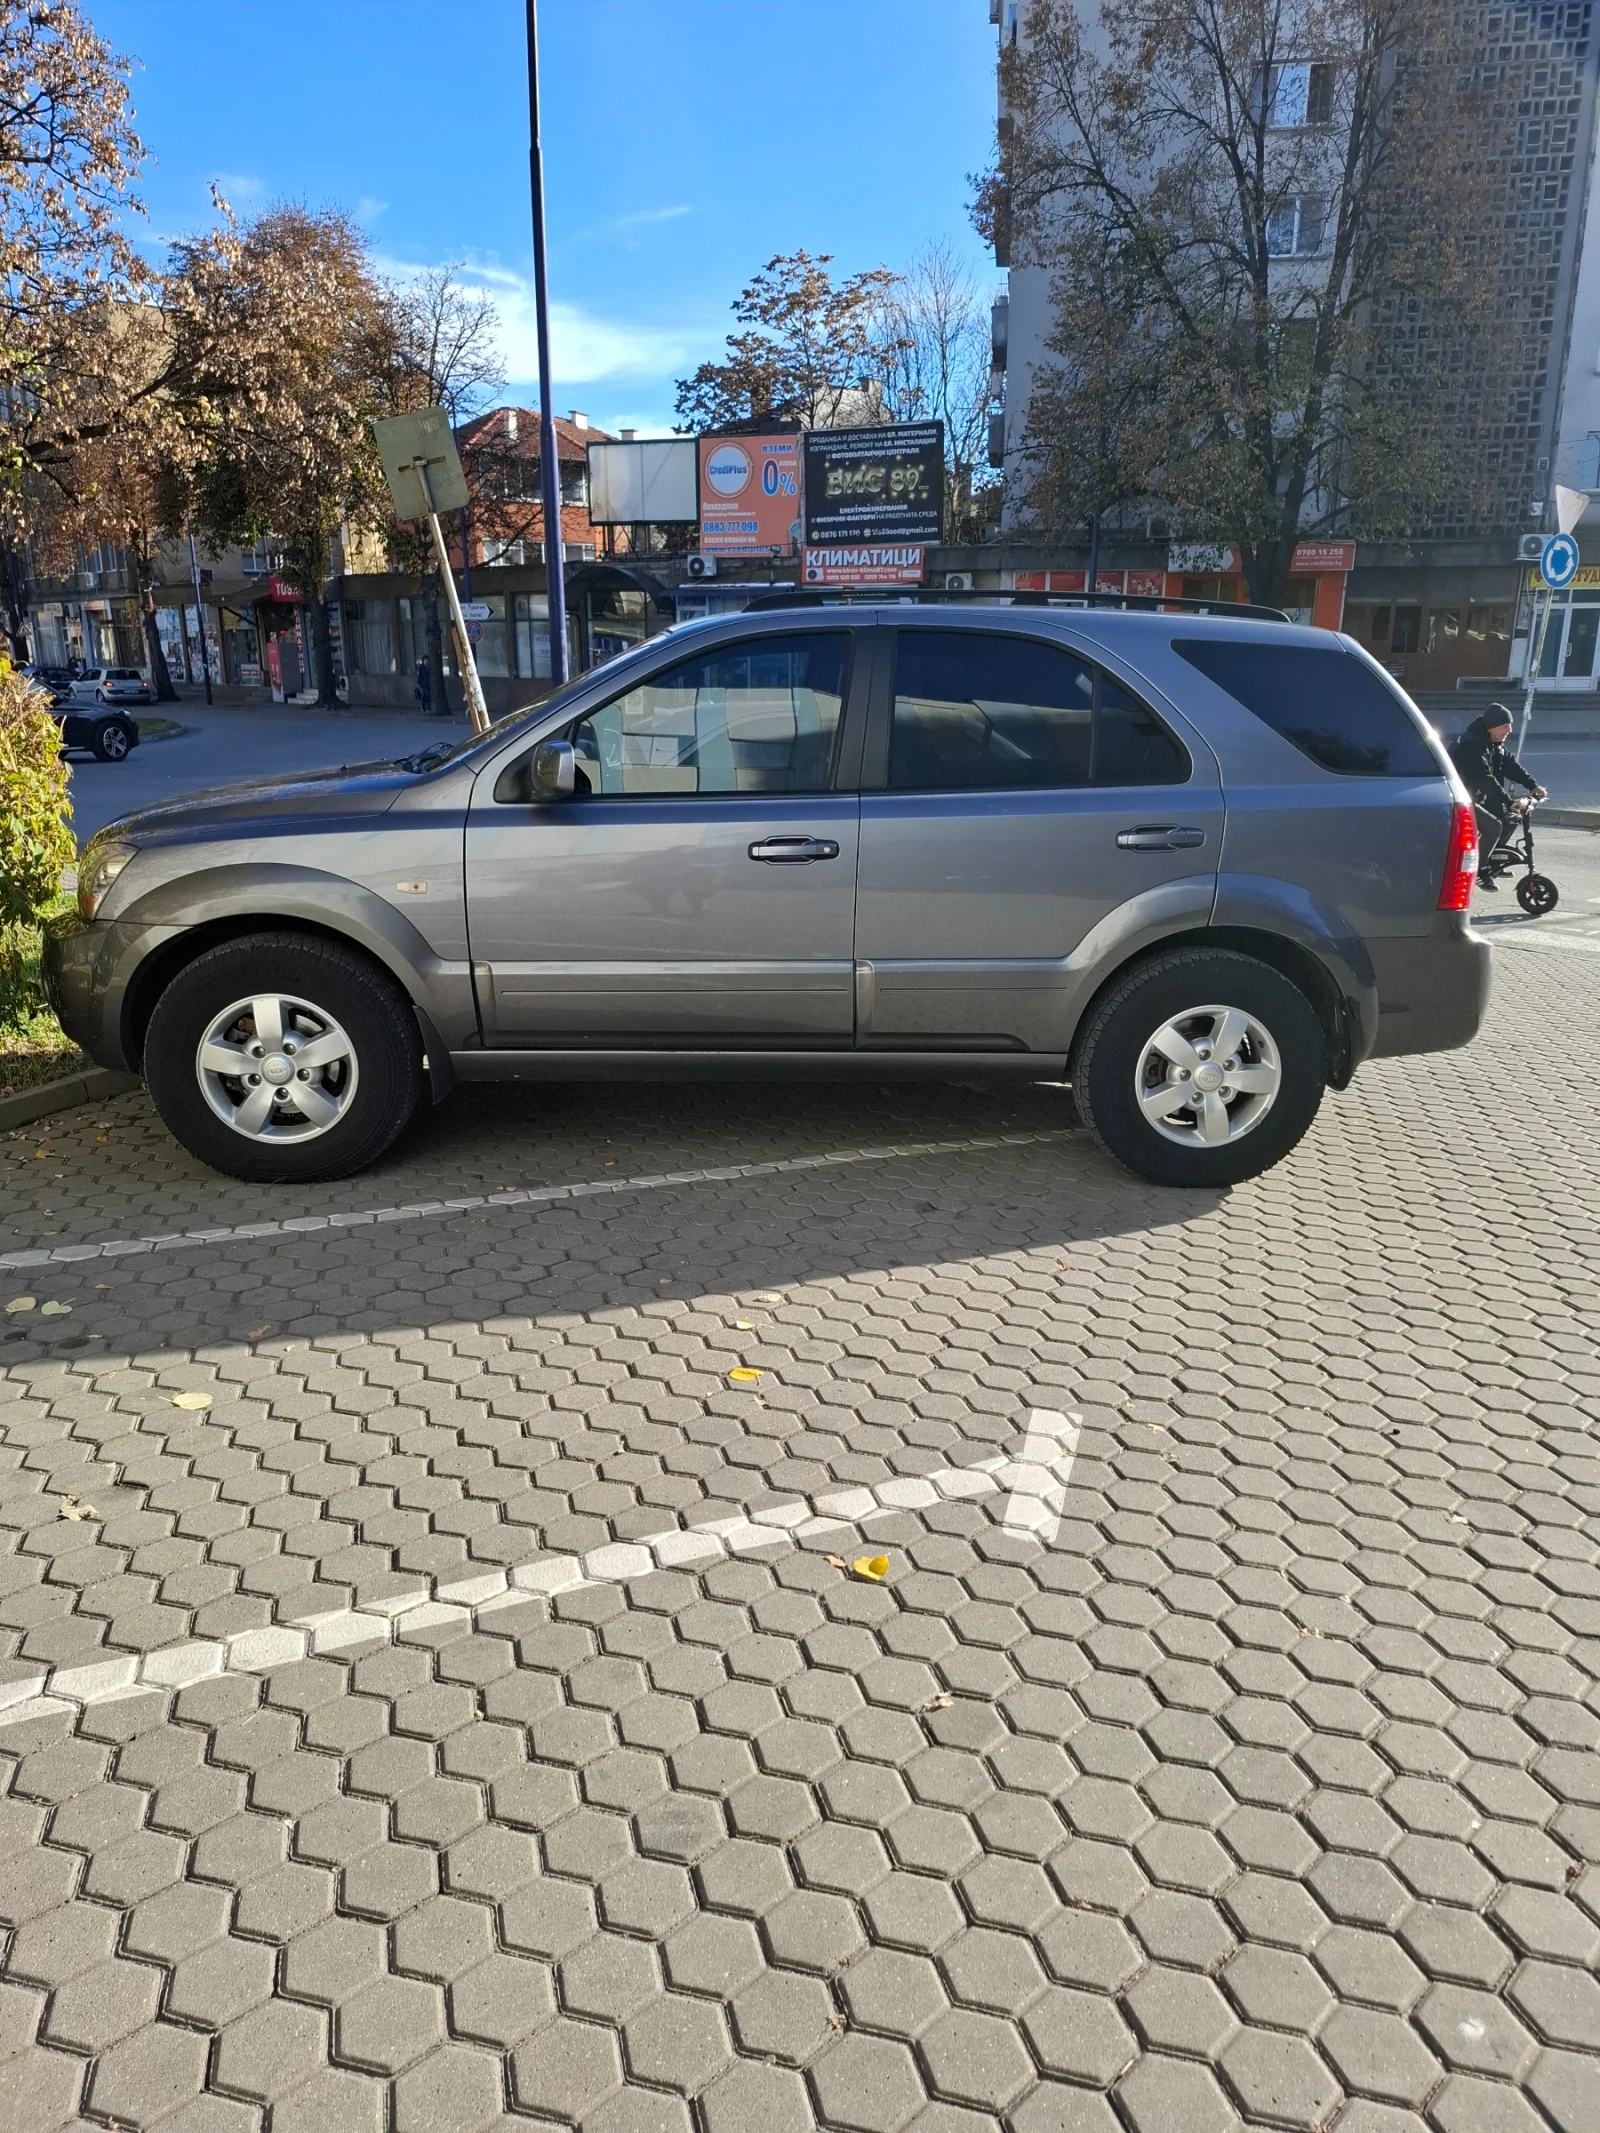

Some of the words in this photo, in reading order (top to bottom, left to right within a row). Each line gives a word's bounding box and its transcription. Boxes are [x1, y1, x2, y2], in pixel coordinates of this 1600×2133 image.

[847, 432, 877, 441] ДОСТАВКА
[850, 441, 874, 450] РЕМОНТ
[709, 465, 748, 475] CrediPlus
[826, 468, 883, 497] ВИС
[890, 468, 920, 491] 89
[918, 510, 938, 518] СРЕДА
[703, 521, 726, 533] 0883
[726, 521, 740, 533] 777
[741, 520, 759, 533] 098
[806, 548, 921, 568] КЛИМАТИЦИ
